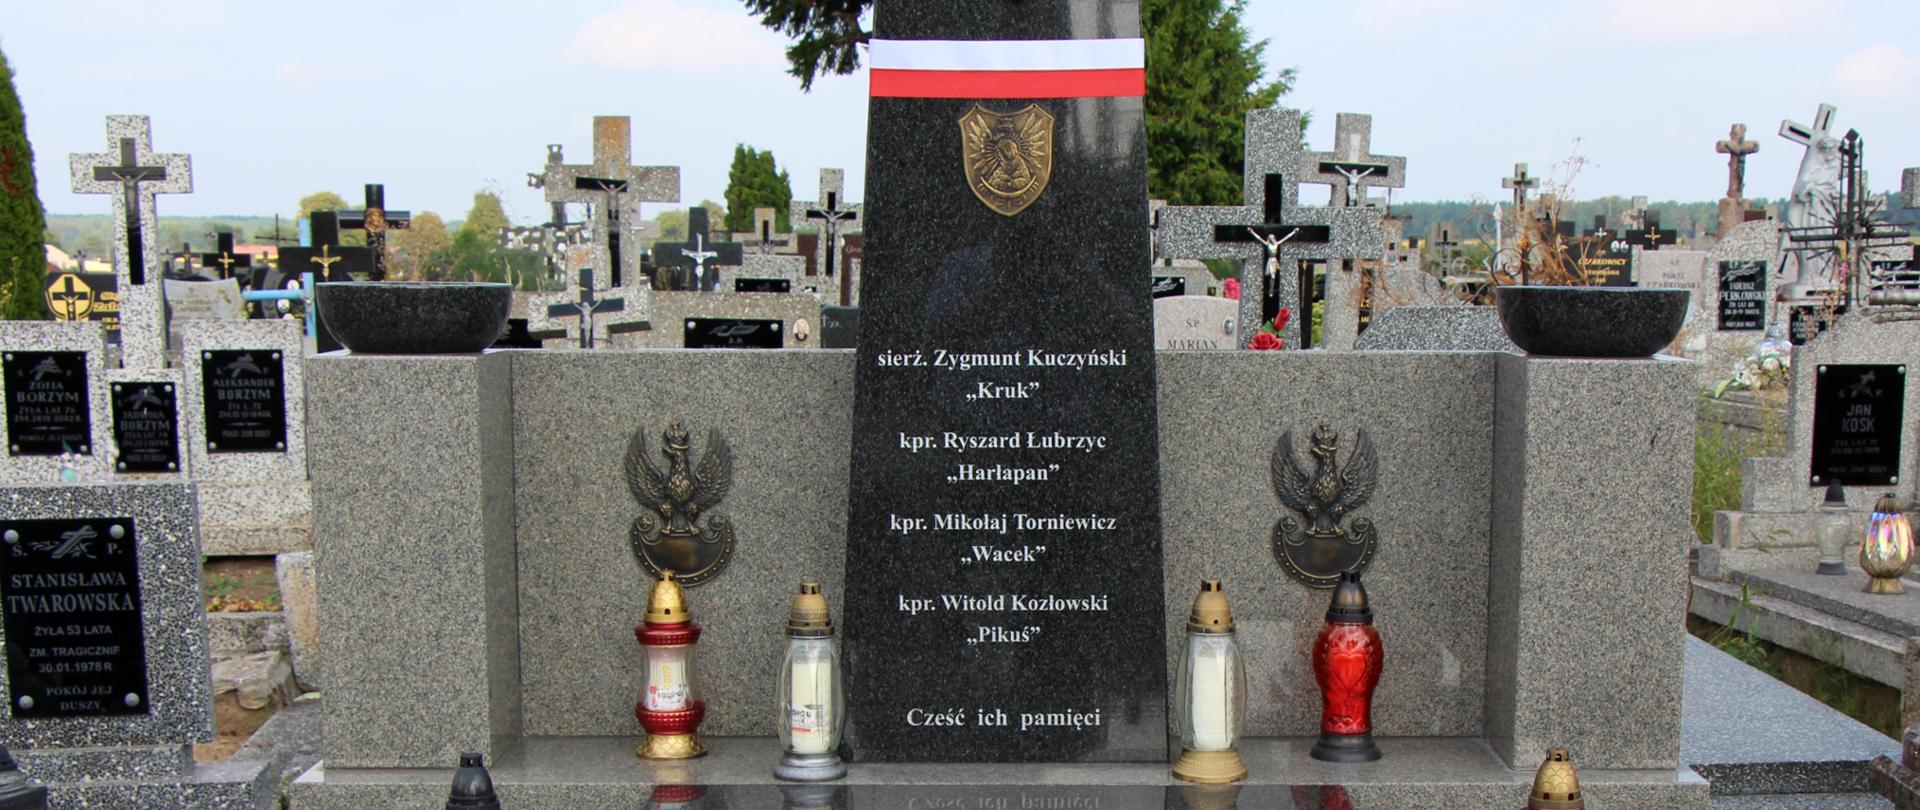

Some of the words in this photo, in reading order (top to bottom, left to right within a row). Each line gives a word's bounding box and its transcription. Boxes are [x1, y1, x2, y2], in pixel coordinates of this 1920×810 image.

[1167, 338, 1218, 350] MARIAN
[878, 349, 928, 367] sierż.
[933, 349, 1022, 371] Zygmunt
[1028, 348, 1127, 371] Kuczyński
[29, 381, 65, 390] ZOFIA
[212, 378, 276, 388] ALEKSANDER
[16, 391, 80, 402] BORZYM
[217, 388, 272, 400] BORZYM
[965, 381, 1040, 402] „Kruk”
[1846, 403, 1873, 417] JAN
[119, 419, 171, 431] BORZYM
[1840, 417, 1877, 433] KOSK
[900, 432, 937, 453] kpr.
[943, 431, 1020, 453] Ryszard
[1026, 431, 1106, 453] Łubrzyc
[947, 463, 1060, 485] „Harłapan”
[890, 513, 928, 535] kpr.
[933, 513, 1007, 535] Mikołaj
[1013, 513, 1116, 530] Torniewicz
[960, 545, 1046, 565] „Wacek”
[11, 571, 129, 589] STANISŁAWA
[7, 592, 136, 614] TWAROWSKA
[899, 594, 936, 616] kpr.
[941, 594, 1005, 611] Witold
[1011, 594, 1108, 611] Kozłowski
[34, 624, 65, 637] ŻYŁA
[66, 624, 81, 636] 53
[83, 624, 113, 636] LATA
[966, 626, 1041, 647] „Pikuś”
[29, 646, 50, 657] ZM.
[46, 683, 88, 697] POKÓJ
[90, 684, 113, 696] JEJ
[59, 700, 101, 711] DUSZY
[906, 708, 965, 726] Cześć
[978, 708, 1008, 726] ich
[1021, 708, 1101, 731] pamięci
